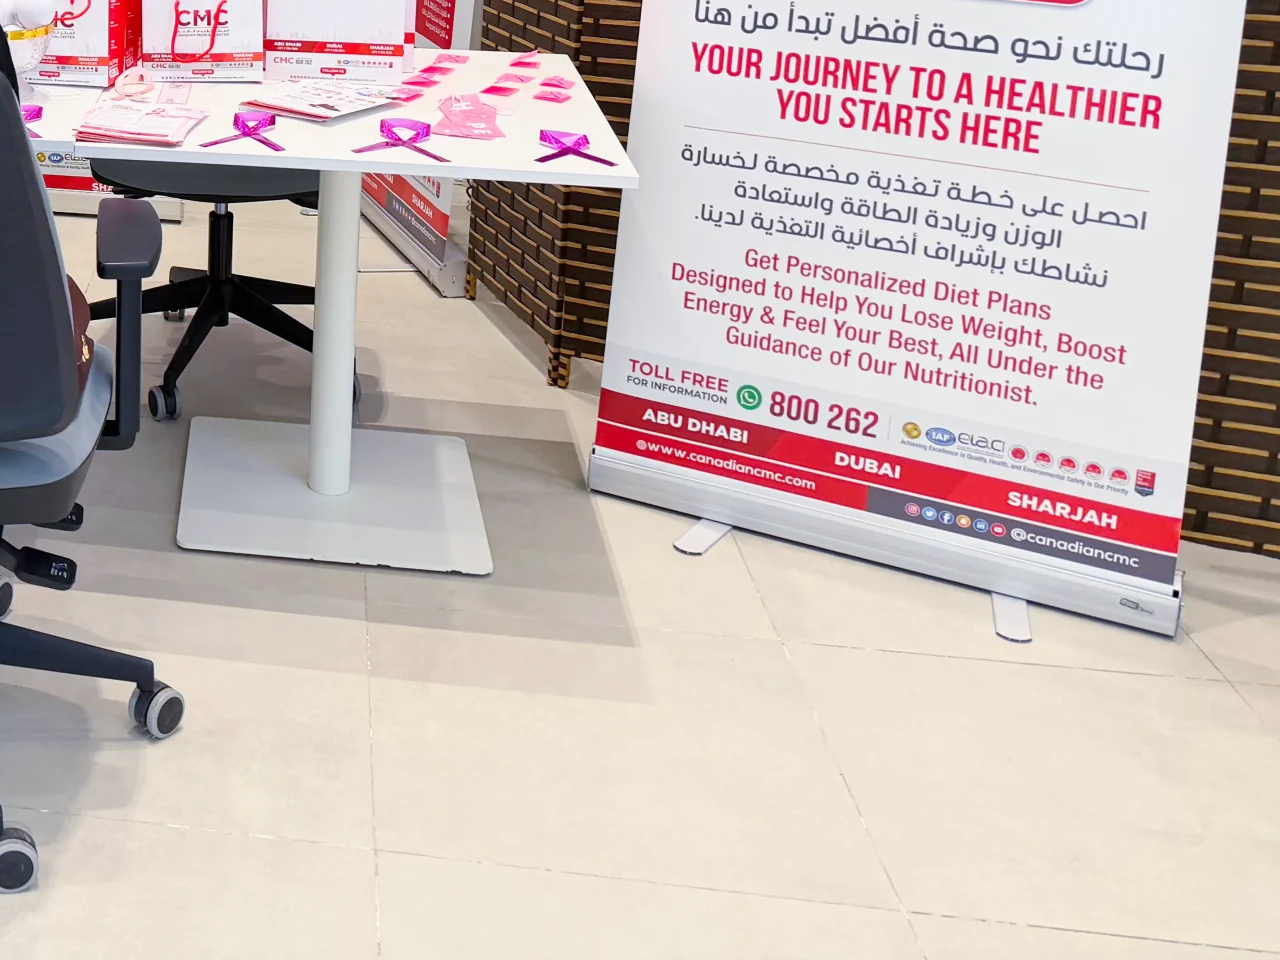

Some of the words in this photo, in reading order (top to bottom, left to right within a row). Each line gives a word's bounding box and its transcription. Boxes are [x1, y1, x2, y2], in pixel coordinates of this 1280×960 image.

[178, 10, 228, 26] CMC
[695, 0, 731, 26] هنا
[741, 4, 778, 33] من
[788, 1, 834, 40] تبدأ
[841, 14, 919, 45] أفضل
[928, 23, 999, 54] صحة
[1011, 36, 1063, 63] نحو
[1073, 40, 1165, 79] رحلتك
[692, 42, 762, 79] YOUR
[770, 51, 901, 95] JOURNEY
[910, 66, 946, 101] TO
[954, 72, 973, 105] A
[984, 75, 1162, 129] HEALTHIER
[777, 89, 831, 125] YOU
[839, 97, 951, 141] STARTS
[960, 112, 1042, 153] HERE
[681, 144, 757, 170] لخسارة
[765, 155, 859, 185] مخصصة
[734, 181, 833, 215] واستعادة
[867, 170, 942, 197] تغذية
[947, 182, 1014, 209] خطة
[695, 204, 744, 227] لدينا.
[841, 196, 918, 225] الطاقة
[1022, 196, 1064, 217] على
[1072, 202, 1147, 230] احصل
[751, 212, 825, 239] التغذية
[832, 225, 917, 255] أخصائية
[925, 210, 996, 241] وزيادة
[1004, 222, 1062, 249] الوزن
[924, 242, 1006, 274] بإشراف
[1014, 256, 1108, 287] نشاطك
[745, 249, 779, 272] Get
[786, 255, 926, 299] Personalized
[934, 281, 979, 307] Diet
[987, 291, 1052, 320] Plans
[672, 263, 766, 296] Designed
[774, 281, 793, 301] to
[801, 285, 848, 314] Help
[856, 295, 893, 320] You
[901, 304, 954, 330] Lose
[961, 314, 1047, 352] Weight,
[1057, 333, 1127, 365] Boost
[683, 291, 754, 323] Energy
[760, 306, 775, 325] &
[783, 310, 826, 335] Feel
[834, 319, 881, 345] Your
[888, 329, 943, 361] Best,
[949, 342, 979, 364] All
[988, 348, 1058, 380] Under
[1066, 364, 1104, 390] the
[629, 359, 674, 382] TOLL
[681, 370, 729, 393] FREE
[726, 326, 822, 361] Guidance
[830, 349, 851, 367] of
[858, 352, 896, 379] Our
[904, 361, 1037, 406] Nutritionist.
[626, 376, 648, 387] FOR
[651, 381, 727, 405] INFORMATION
[642, 409, 682, 427] ABU
[688, 417, 748, 443] DHABI
[770, 391, 819, 425] 800
[827, 403, 879, 438] 262
[932, 431, 950, 441] IAF
[648, 442, 816, 490] www.canadiancmc.com
[835, 451, 901, 479] DUBAI
[901, 439, 927, 450] Achieving
[929, 446, 958, 456] Excellence
[1023, 466, 1065, 480] Environmental
[1067, 476, 1085, 486] Safety
[1107, 485, 1128, 495] Priority
[1007, 491, 1118, 529] SHARJAH
[1011, 528, 1140, 568] @canadiancmc
